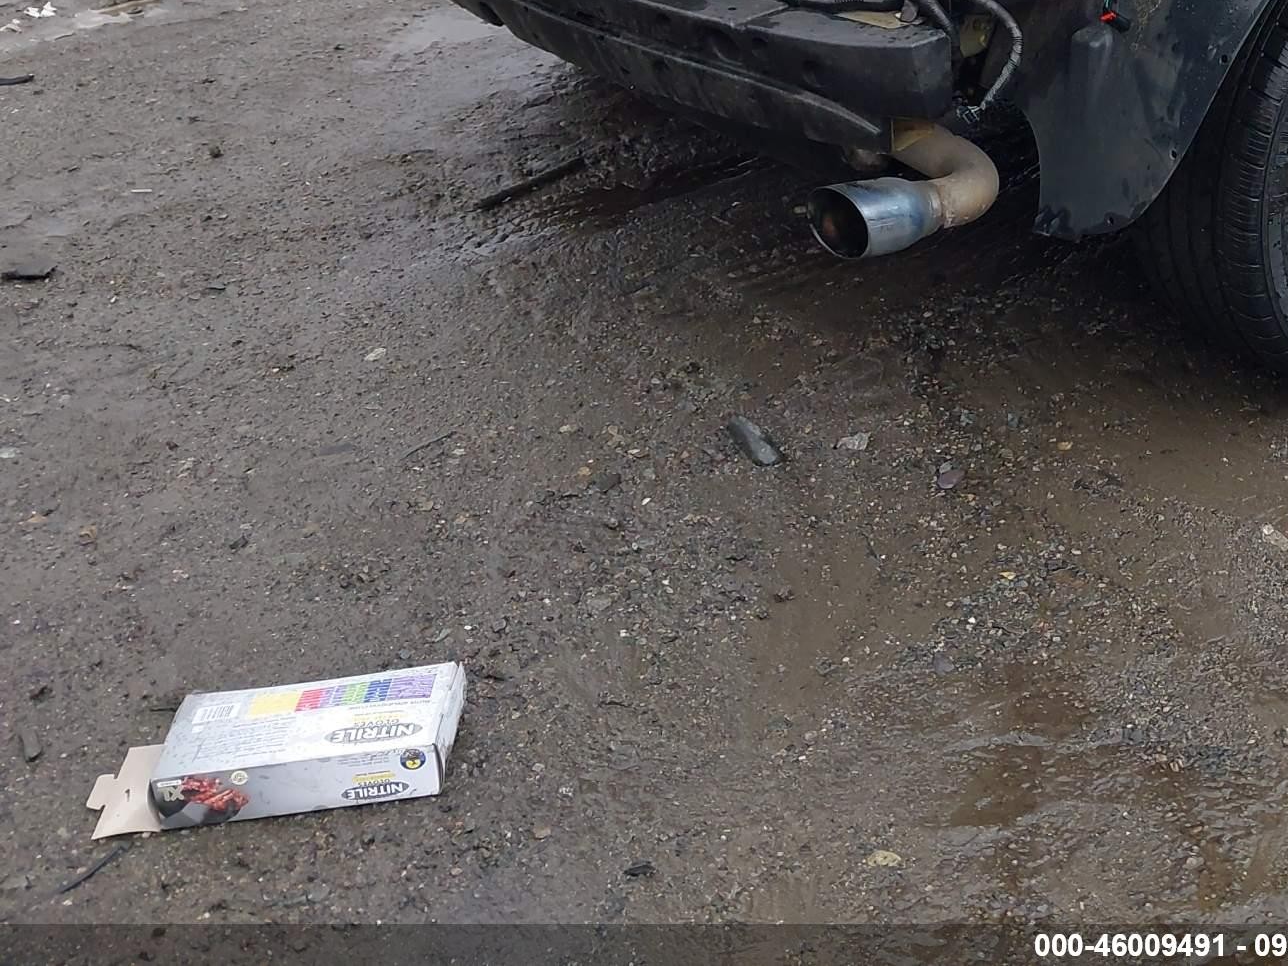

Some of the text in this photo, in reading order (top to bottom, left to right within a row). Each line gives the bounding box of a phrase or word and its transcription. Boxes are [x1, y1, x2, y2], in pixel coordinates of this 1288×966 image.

[331, 724, 415, 743] NITRILE
[159, 786, 184, 801] XL
[346, 783, 403, 801] NITRILE
